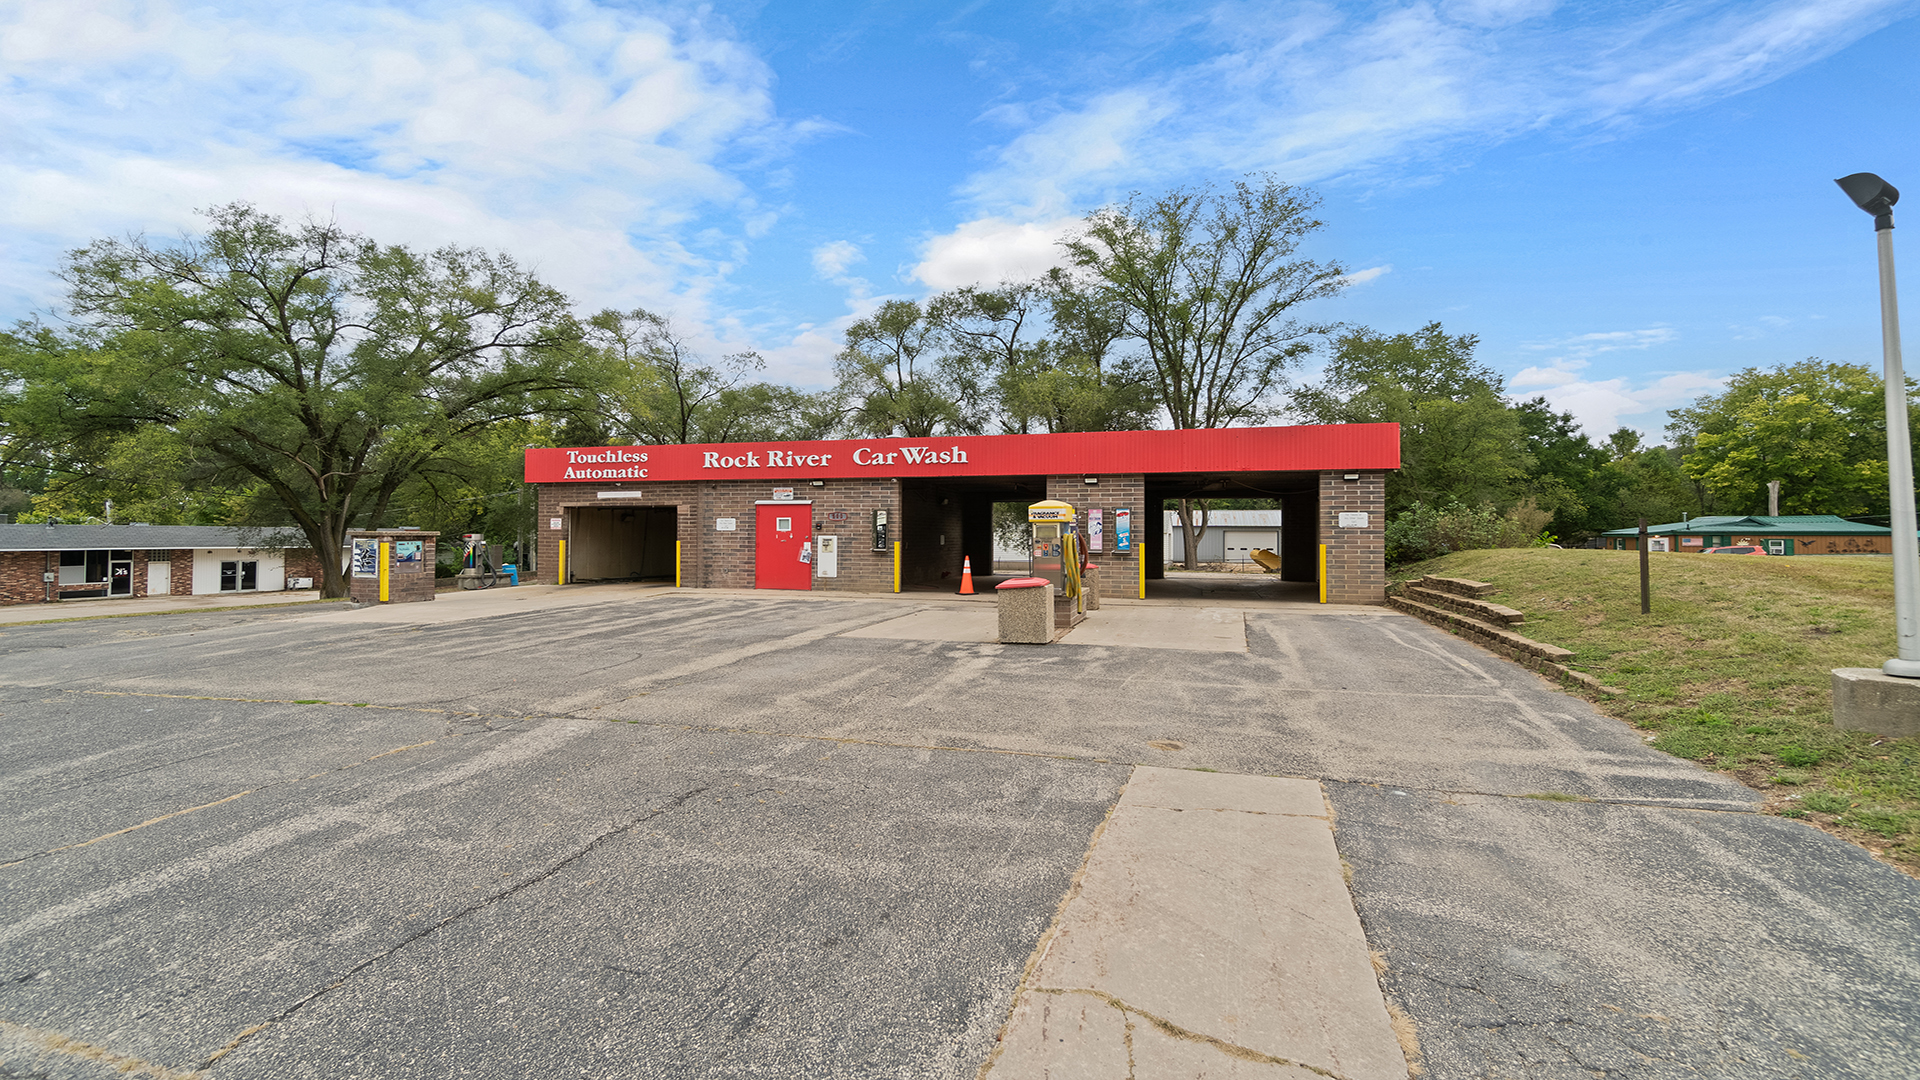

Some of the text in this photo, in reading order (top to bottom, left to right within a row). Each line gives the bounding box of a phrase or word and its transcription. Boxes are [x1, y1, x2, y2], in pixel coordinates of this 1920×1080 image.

[566, 449, 649, 464] Touchless
[702, 445, 969, 469] Rock River Car Wash
[563, 464, 649, 479] Automatic
